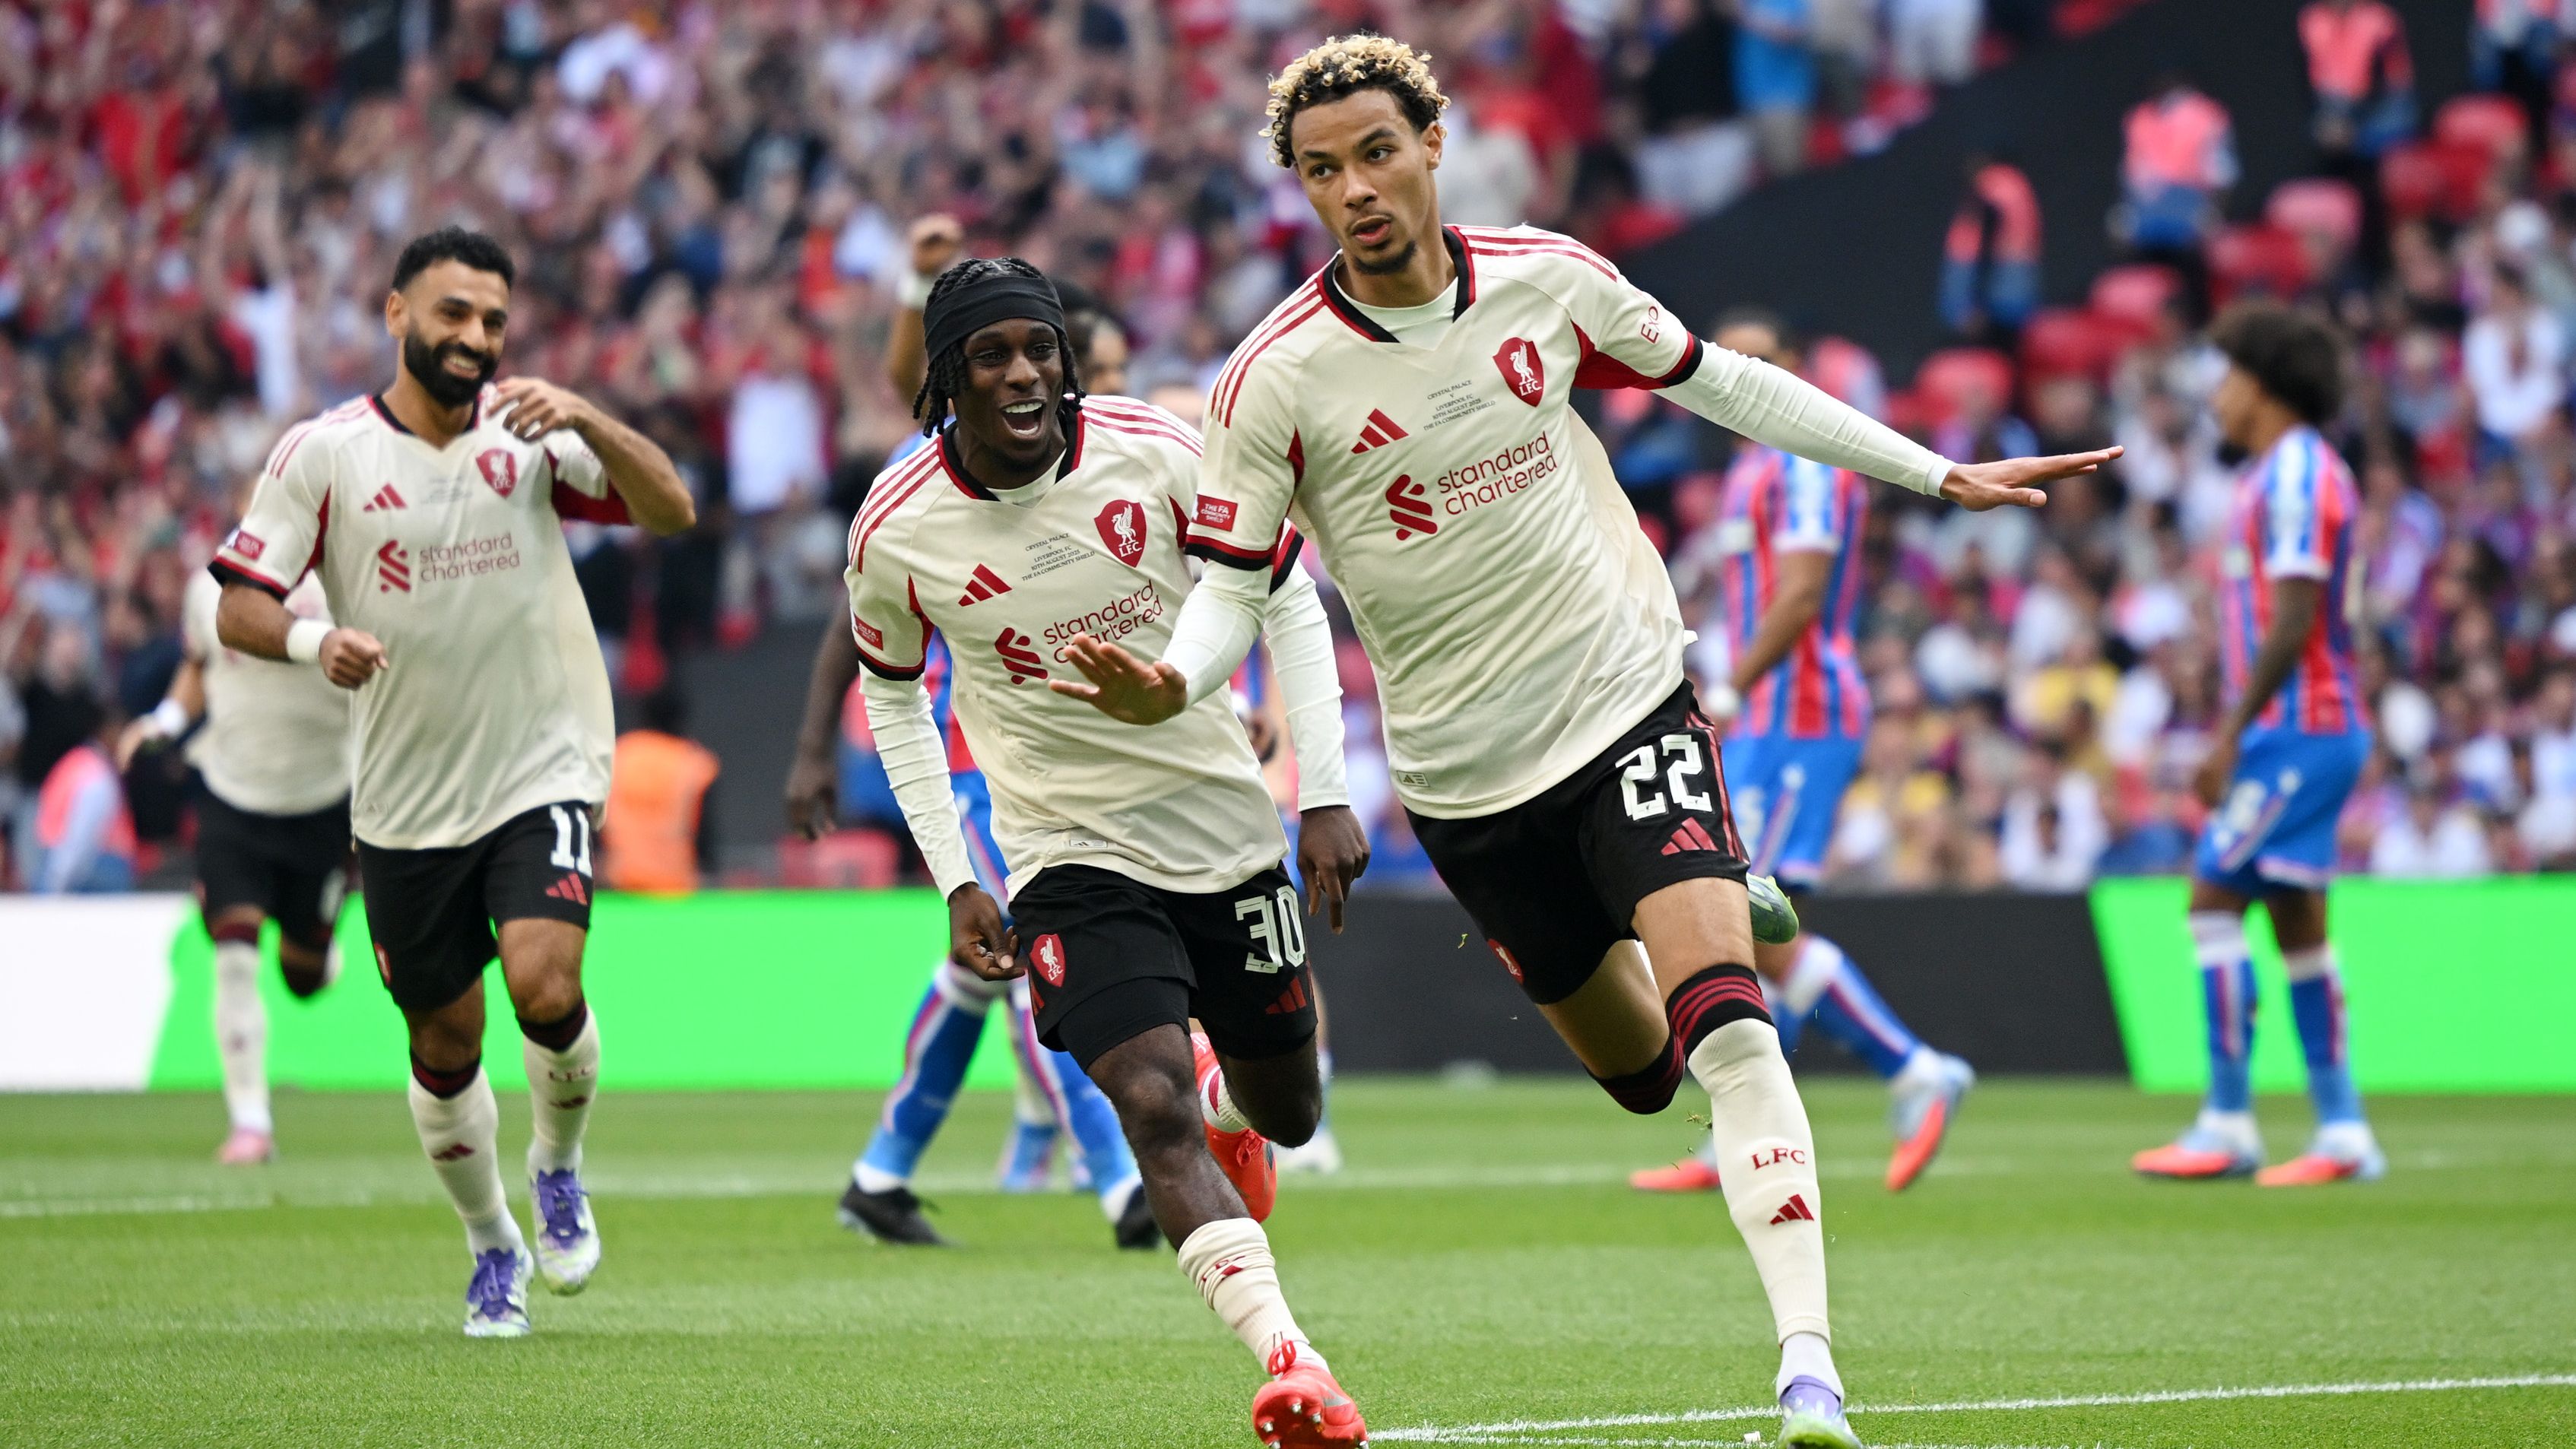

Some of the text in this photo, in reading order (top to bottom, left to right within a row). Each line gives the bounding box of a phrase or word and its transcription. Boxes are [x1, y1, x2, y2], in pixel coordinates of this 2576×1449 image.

[1427, 379, 1472, 400] CRYSTAL PALACE
[1423, 423, 1435, 431] THE
[1442, 407, 1476, 423] COMMUNITY
[1476, 400, 1496, 411] SHIELD
[1436, 398, 1466, 411] LIVERPOOL
[1447, 403, 1468, 414] AUGUST
[1438, 430, 1550, 494] standard
[1445, 451, 1557, 515] chartered
[1201, 509, 1231, 520] COMMUNITY
[1204, 503, 1229, 515] THE FA
[1206, 515, 1223, 523] SHIELD
[420, 531, 512, 563] standard
[1025, 533, 1069, 551] CRYSTAL PALACE
[1034, 548, 1064, 563] LIVERPOOL
[420, 550, 521, 582] chartered
[1022, 573, 1033, 582] THE
[1041, 558, 1075, 574] COMMUNITY
[1075, 550, 1095, 561] SHIELD
[1031, 549, 1080, 571] 10TH AUGUST 2025
[1043, 579, 1154, 645] standard
[1615, 734, 1713, 821] 22
[550, 806, 592, 878] 11
[1235, 885, 1305, 974] 30
[1750, 1147, 1805, 1170] LFC
